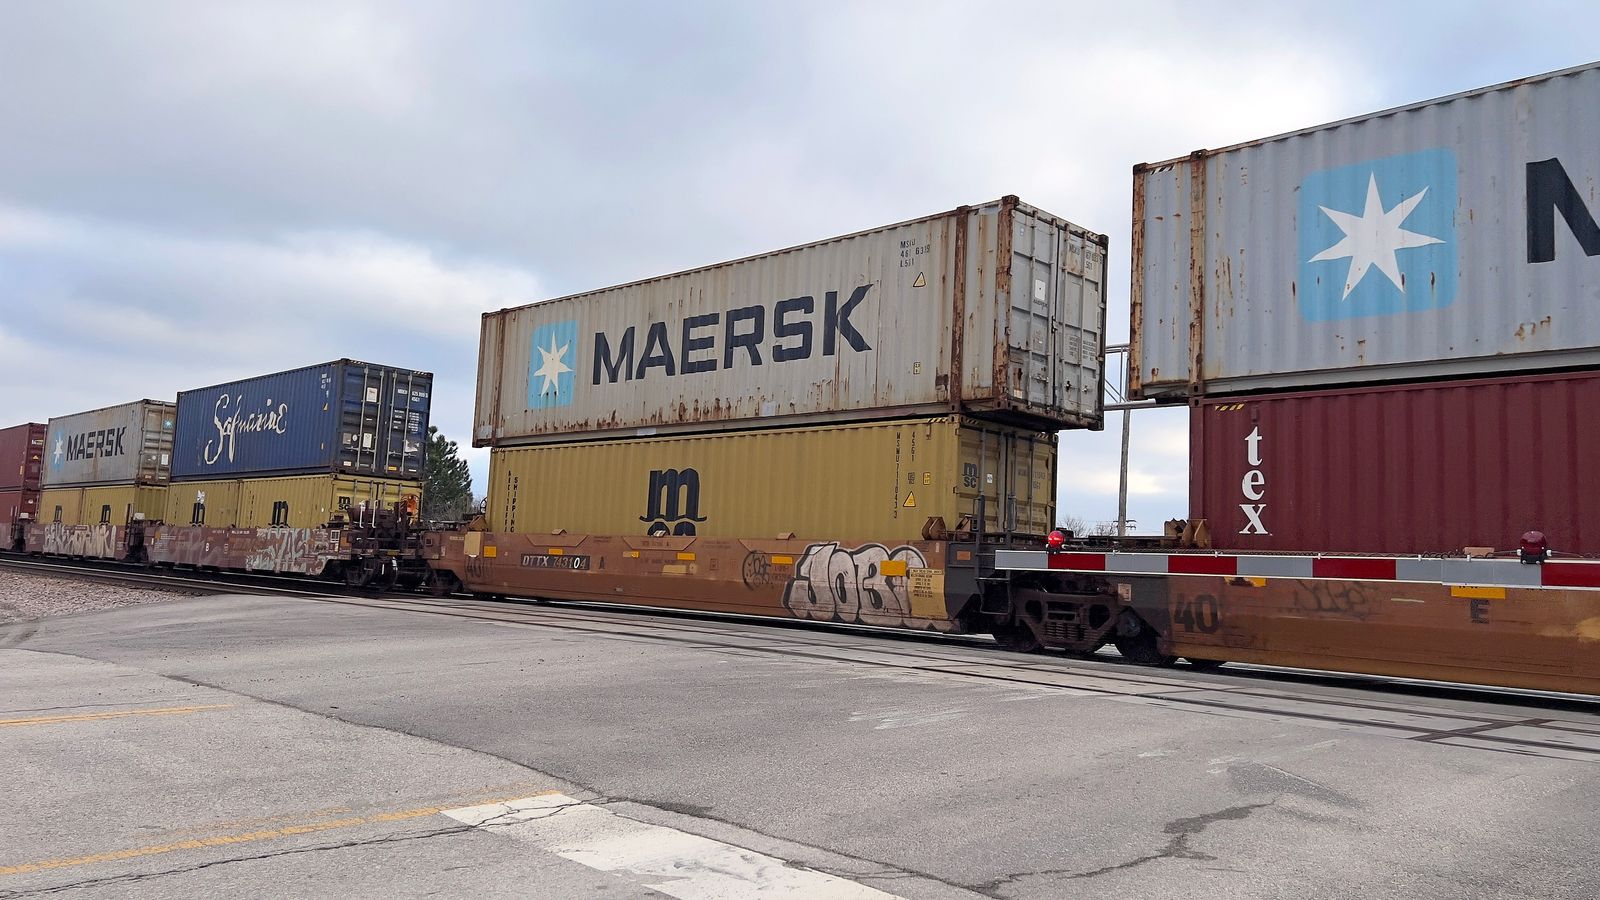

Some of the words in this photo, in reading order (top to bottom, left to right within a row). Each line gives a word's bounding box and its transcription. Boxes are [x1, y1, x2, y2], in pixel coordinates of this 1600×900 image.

[592, 283, 874, 387] MAERSK
[66, 426, 127, 462] MAERSK
[510, 477, 518, 533] SHIPPING
[522, 556, 549, 567] DTTX
[551, 556, 587, 570] 743104
[1173, 592, 1219, 634] 40
[1470, 598, 1490, 625] E
